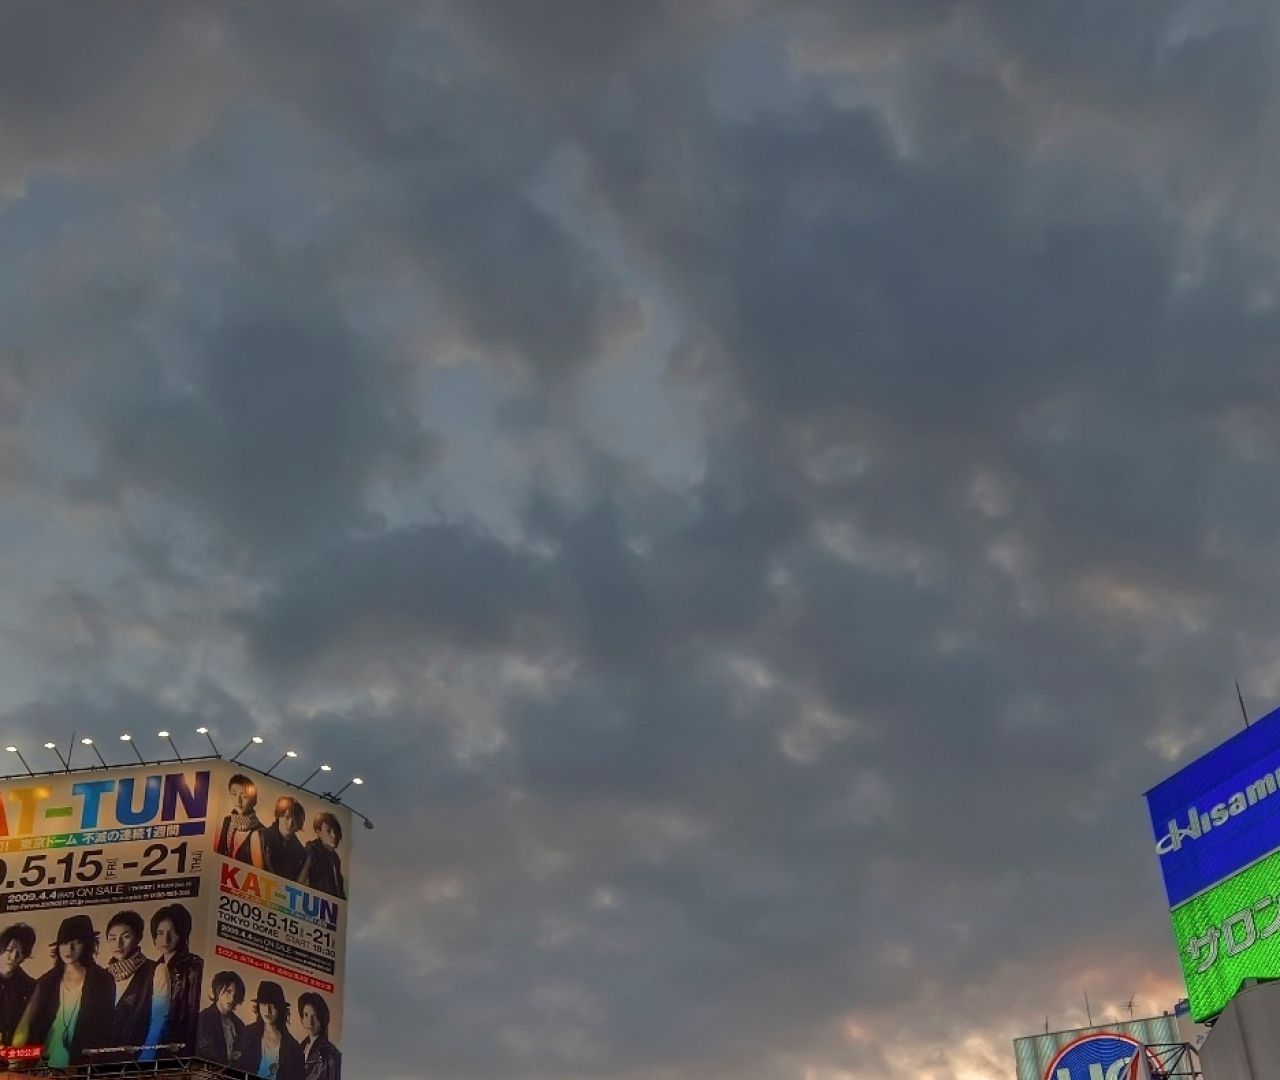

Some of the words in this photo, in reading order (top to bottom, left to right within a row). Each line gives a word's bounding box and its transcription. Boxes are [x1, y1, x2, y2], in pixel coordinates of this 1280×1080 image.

[82, 825, 180, 843] 不滅の連続1週間
[76, 887, 94, 898] ON
[95, 885, 123, 896] SALE
[220, 862, 338, 926] KAT-TUN
[219, 895, 299, 935] 2009.5.15
[219, 911, 250, 927] TOKYO
[253, 922, 279, 938] DOME
